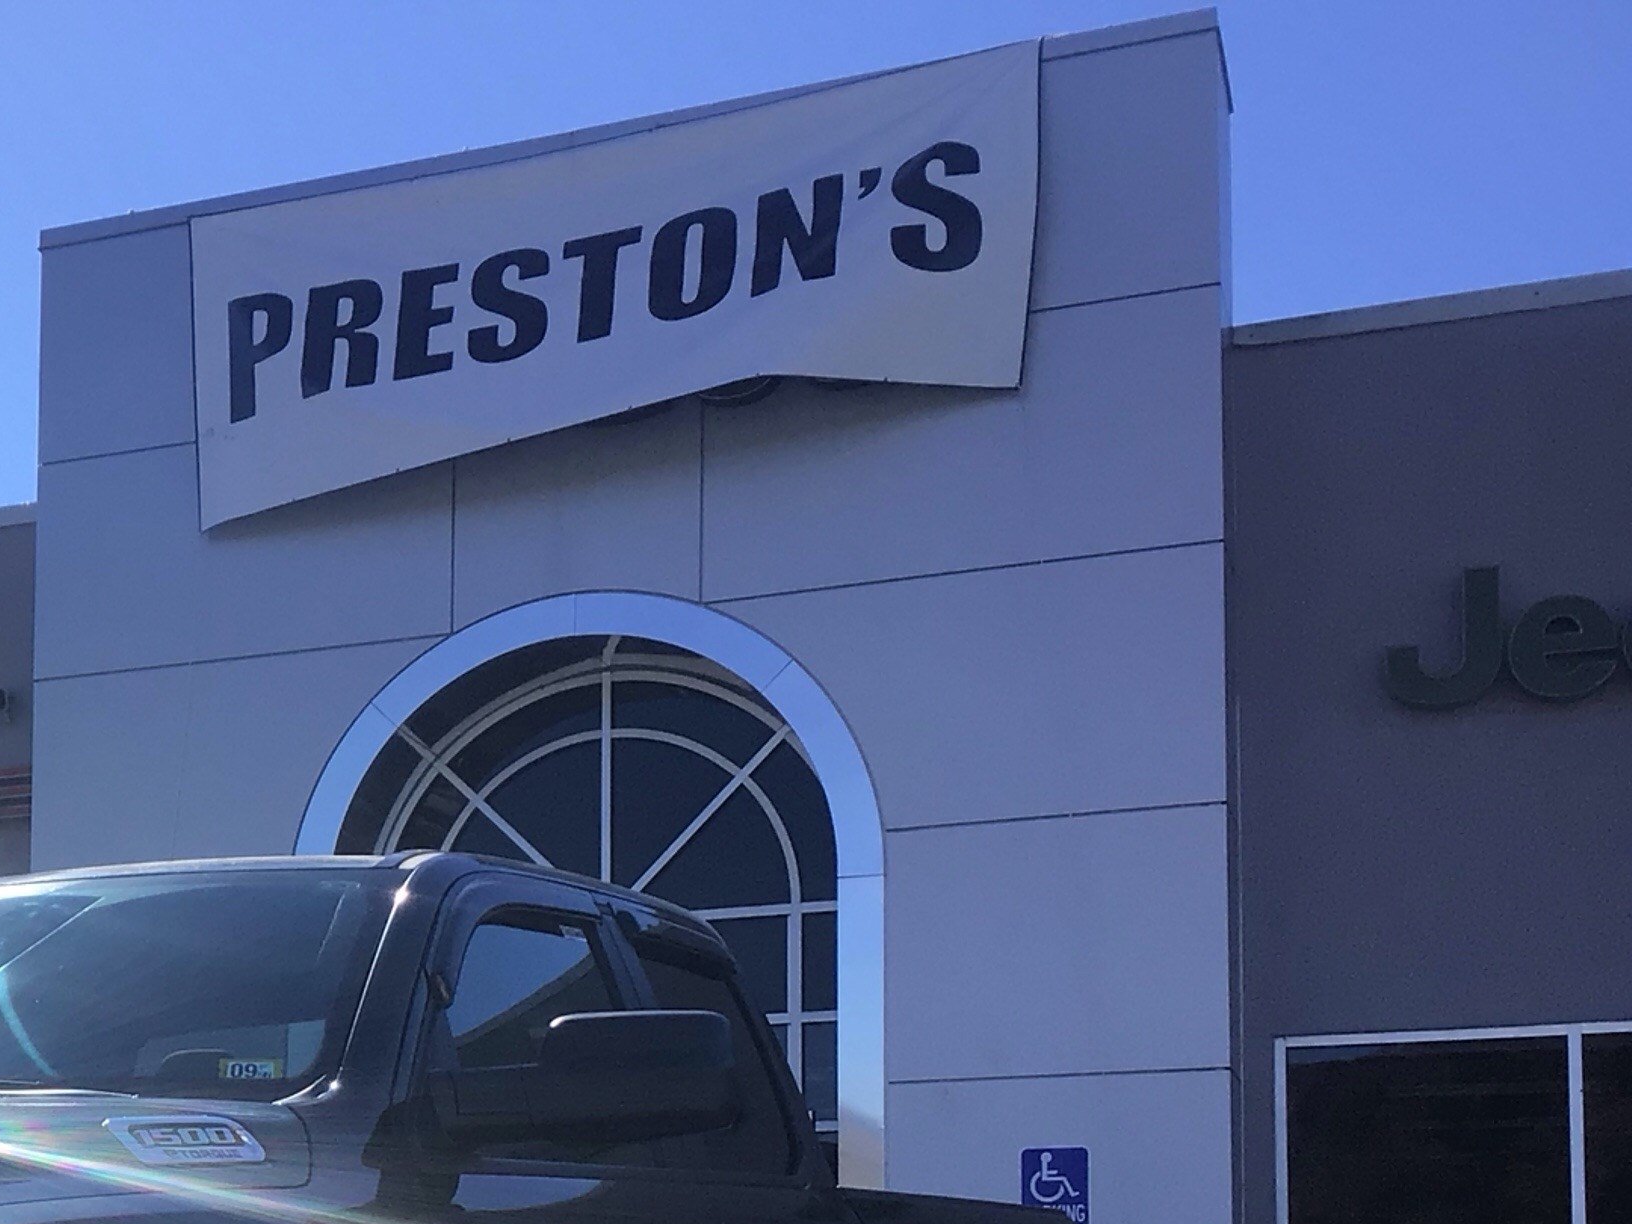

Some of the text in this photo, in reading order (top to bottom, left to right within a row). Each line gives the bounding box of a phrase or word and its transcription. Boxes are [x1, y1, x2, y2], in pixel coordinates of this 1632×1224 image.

[227, 141, 983, 424] PRESTON'S
[1383, 565, 1632, 710] Je
[132, 1127, 236, 1146] 1500
